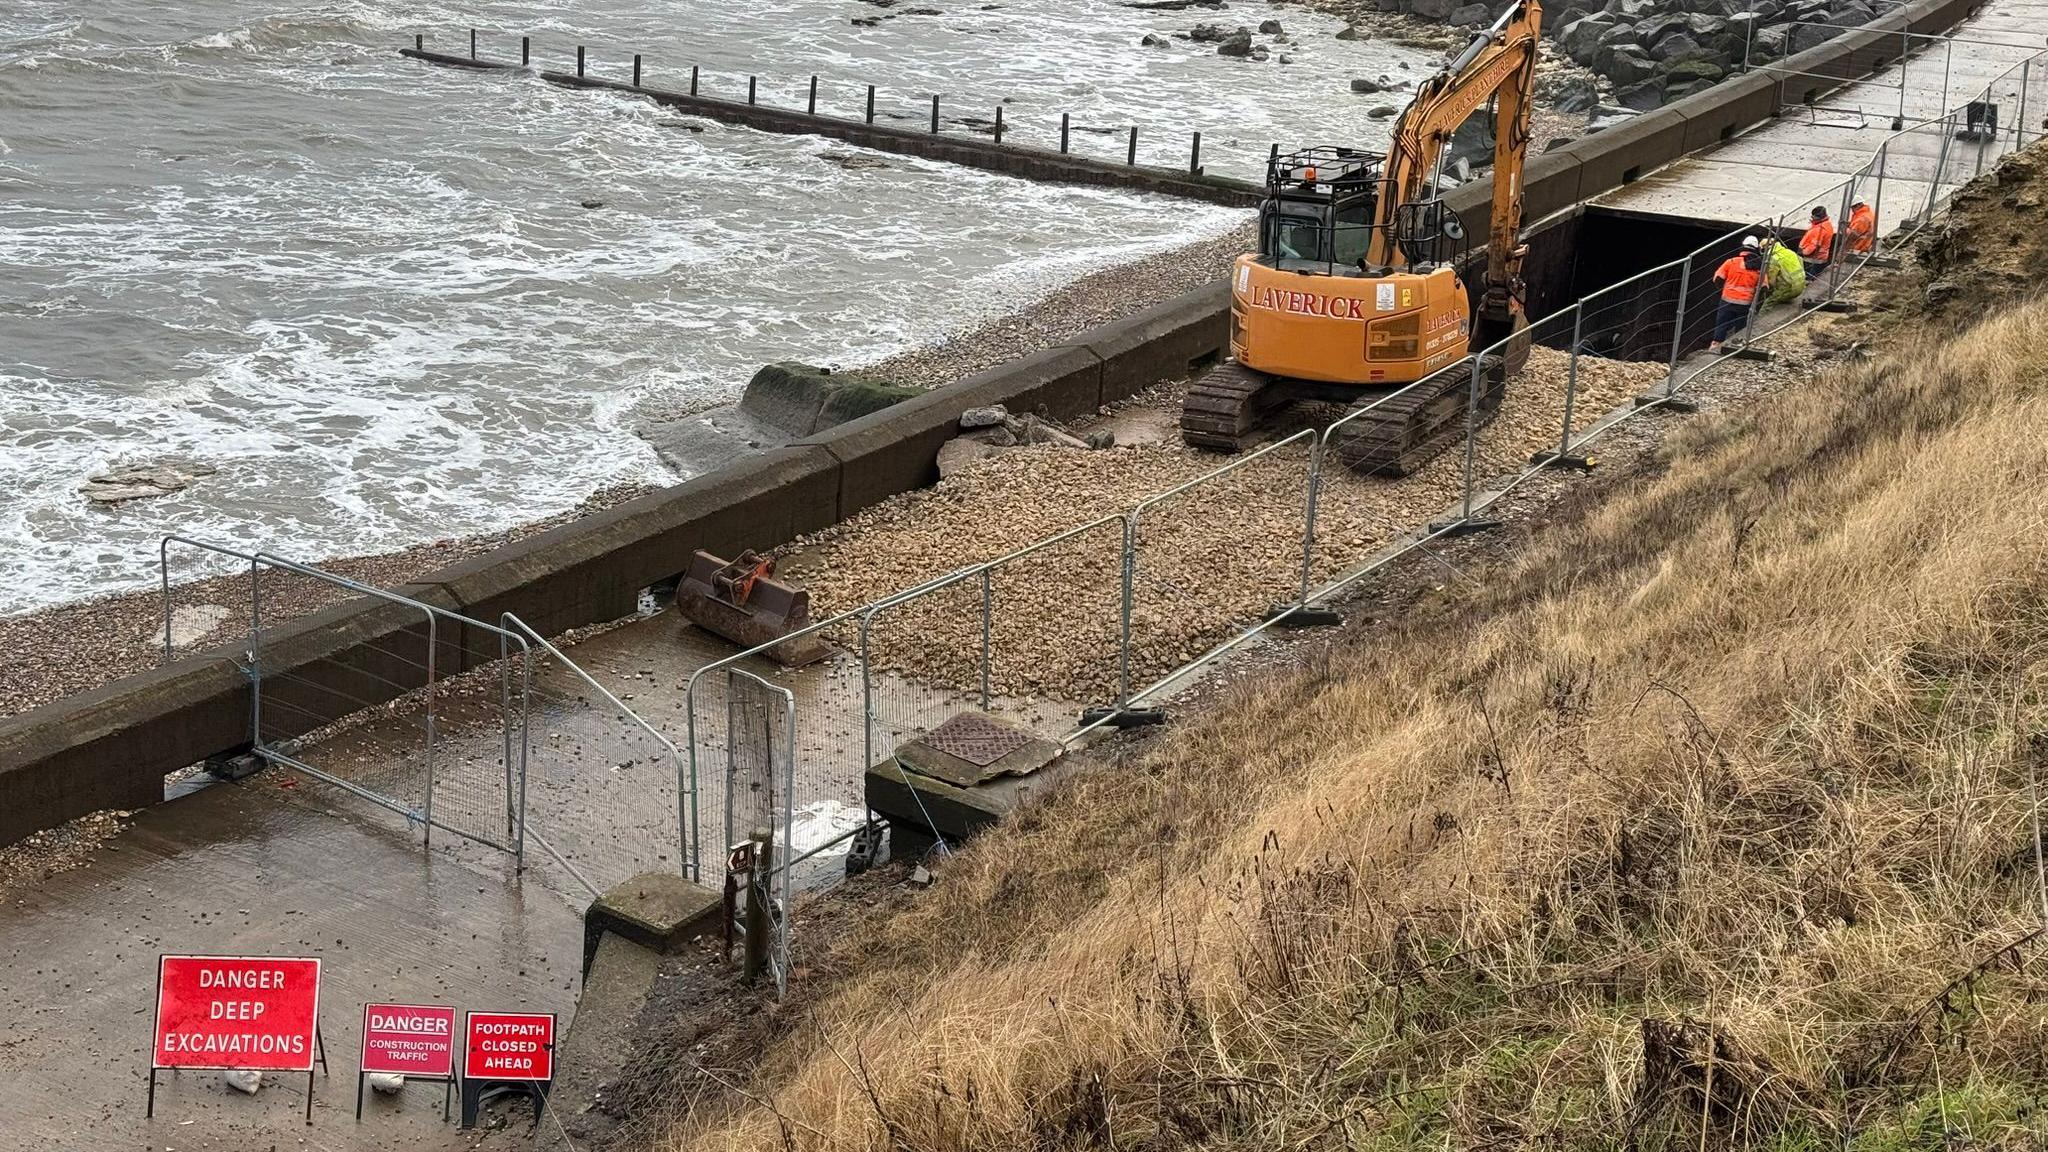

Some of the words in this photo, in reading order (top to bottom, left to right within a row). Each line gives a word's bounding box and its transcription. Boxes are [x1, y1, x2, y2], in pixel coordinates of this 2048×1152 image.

[1250, 285, 1365, 321] LAVERICK
[199, 969, 285, 989] DANGER
[210, 1001, 265, 1020] DEEP
[371, 1015, 448, 1032] DANGER
[475, 1023, 545, 1036] FOOTPATH
[164, 1033, 304, 1054] EXCAVATIONS
[369, 1040, 447, 1051] CONSTRUCTION
[481, 1040, 537, 1053] CLOSED
[387, 1051, 428, 1061] TRAFFIC
[484, 1057, 532, 1069] AHEAD
